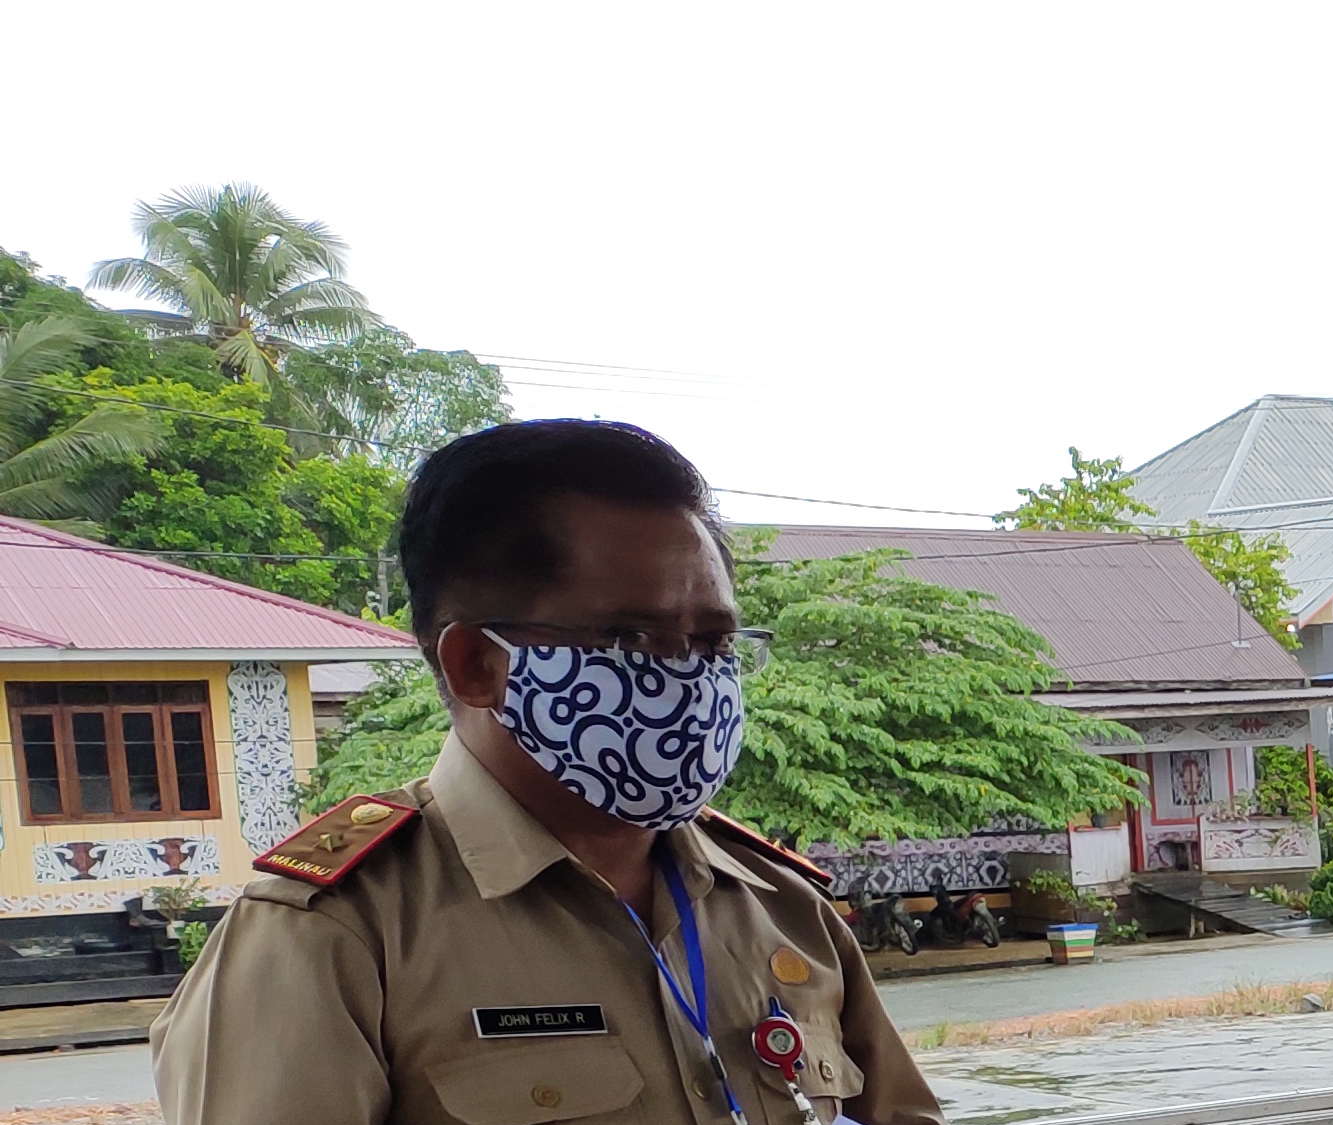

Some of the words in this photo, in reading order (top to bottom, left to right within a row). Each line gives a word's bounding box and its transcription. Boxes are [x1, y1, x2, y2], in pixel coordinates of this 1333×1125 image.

[267, 854, 333, 877] MALINAU
[498, 1013, 531, 1027] JOHN
[535, 1012, 570, 1026] FELIX
[575, 1011, 586, 1024] R
